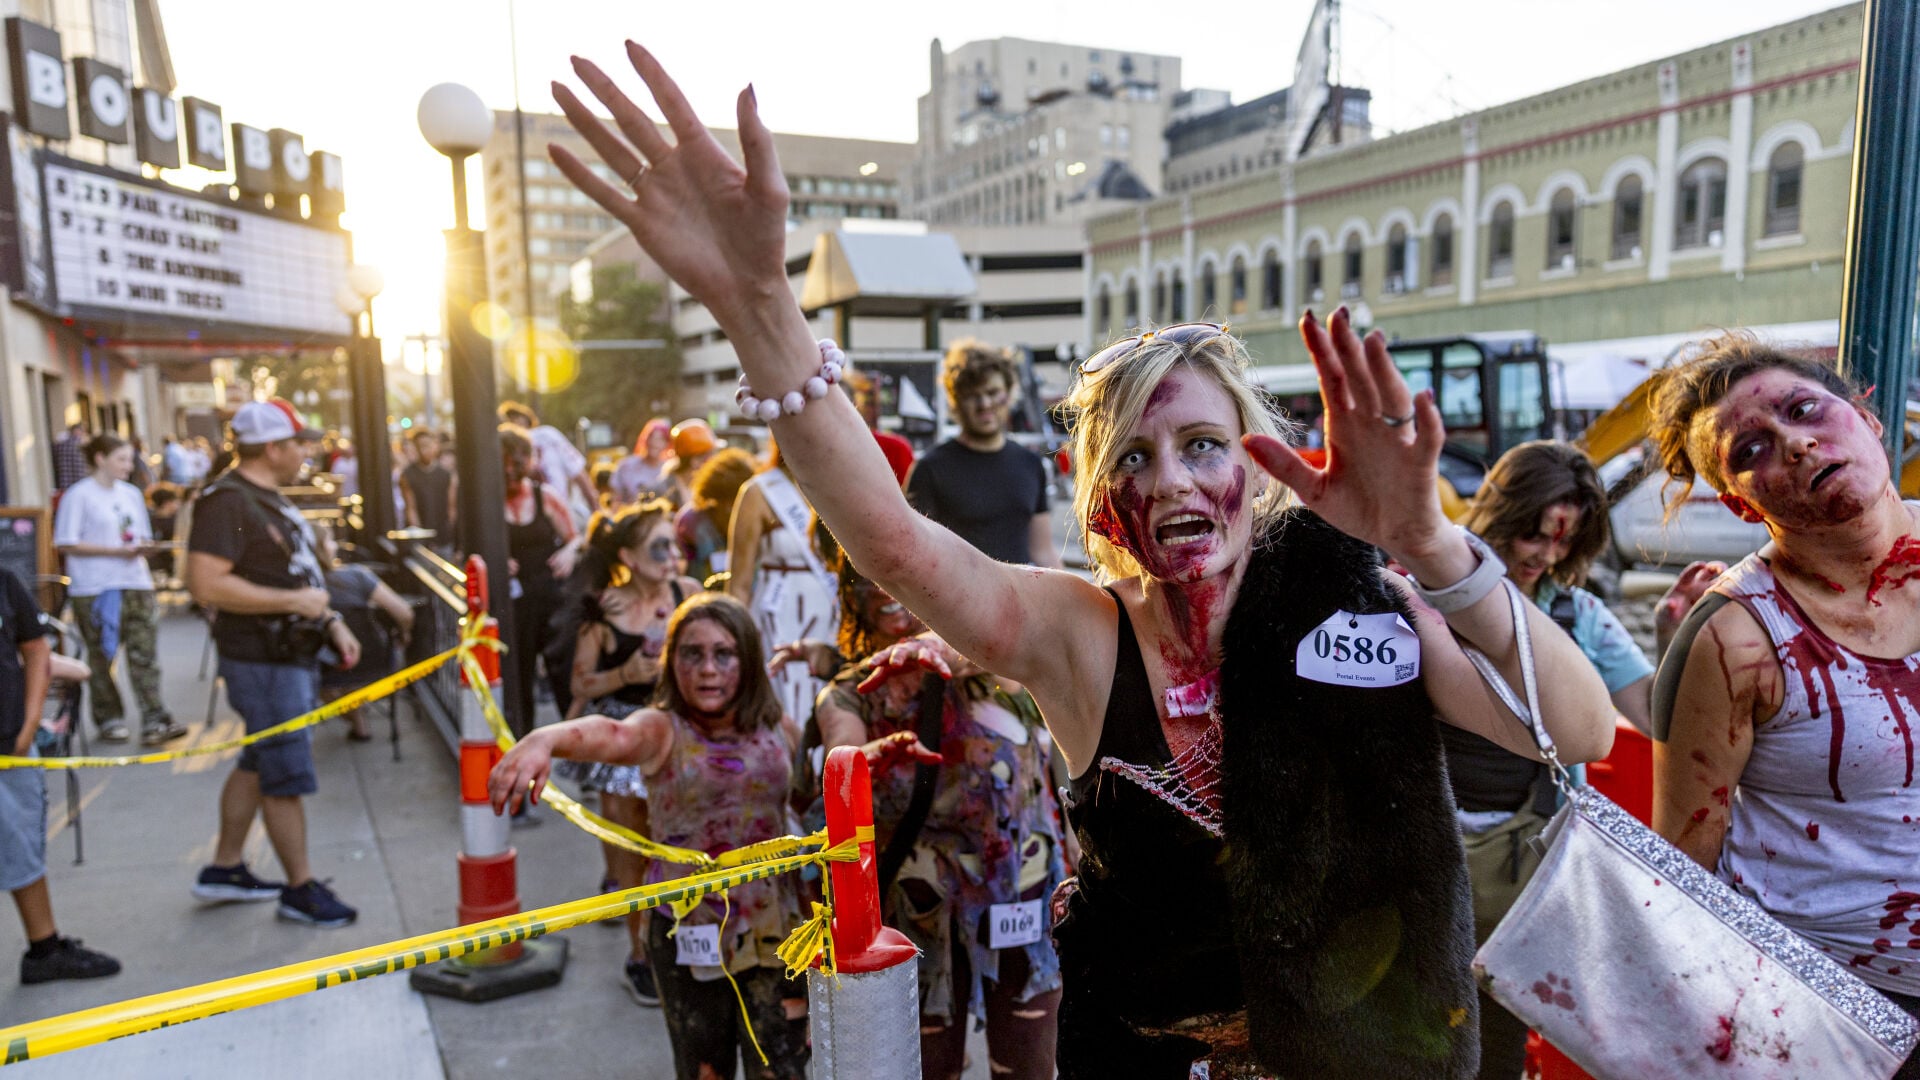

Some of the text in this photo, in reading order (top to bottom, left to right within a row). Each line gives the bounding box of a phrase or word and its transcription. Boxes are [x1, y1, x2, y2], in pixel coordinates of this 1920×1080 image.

[1314, 629, 1397, 665] 0586
[1355, 673, 1376, 682] Events
[1000, 913, 1034, 935] 0169
